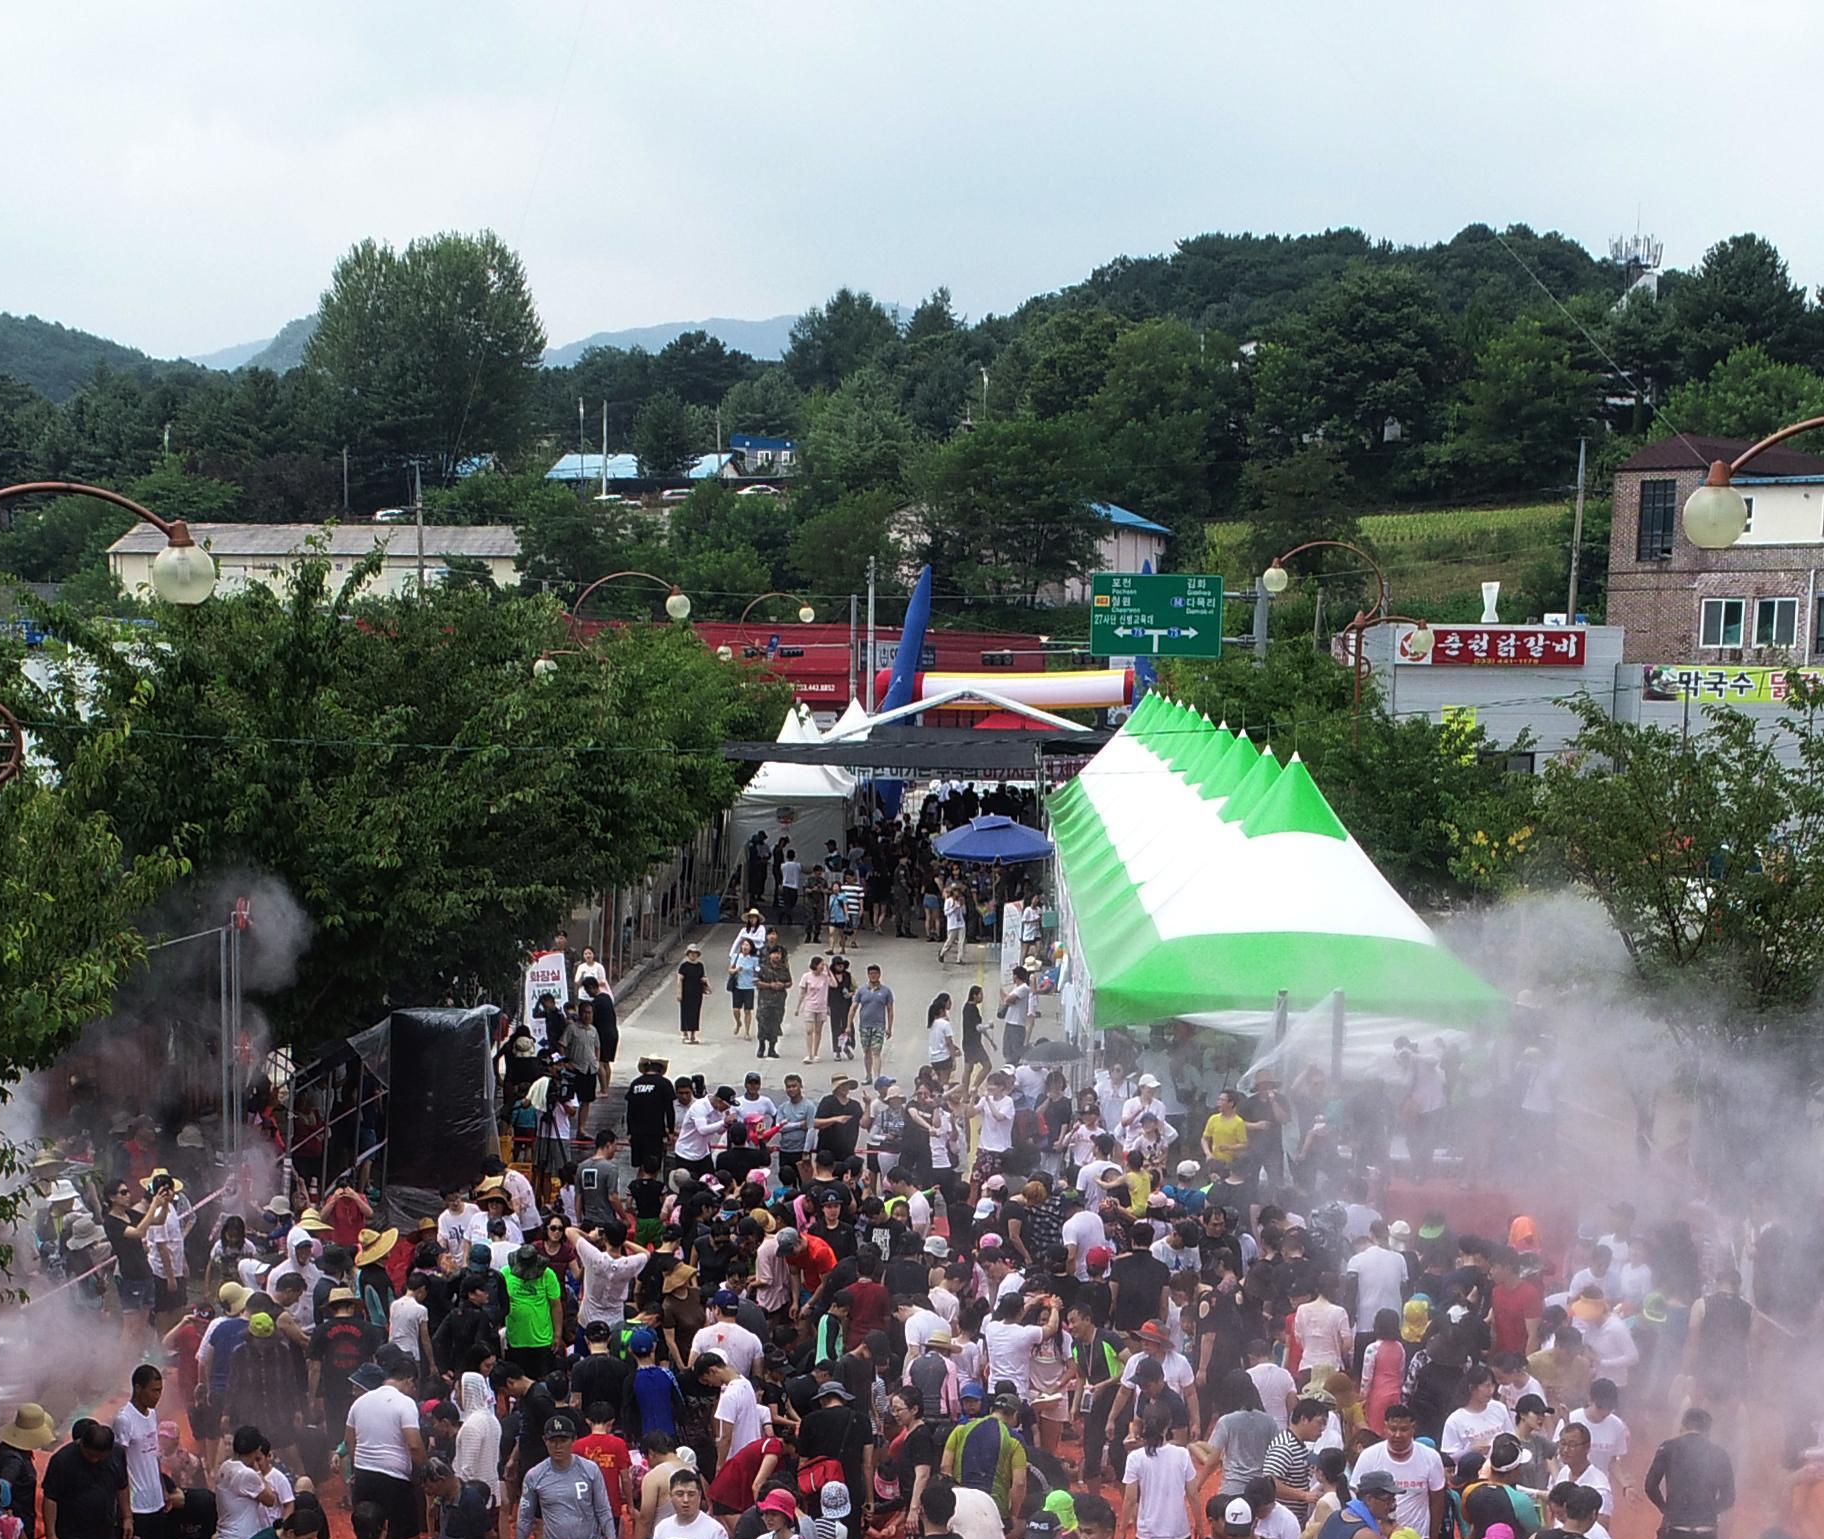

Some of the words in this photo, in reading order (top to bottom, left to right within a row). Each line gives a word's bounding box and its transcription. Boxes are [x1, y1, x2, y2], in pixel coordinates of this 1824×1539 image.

[1186, 598, 1216, 608] 다목리
[1678, 671, 1754, 698] 막국수
[530, 970, 561, 982] 화장실
[633, 1085, 655, 1095] STAFF
[576, 1482, 588, 1499] P
[1028, 1522, 1049, 1530] PING
